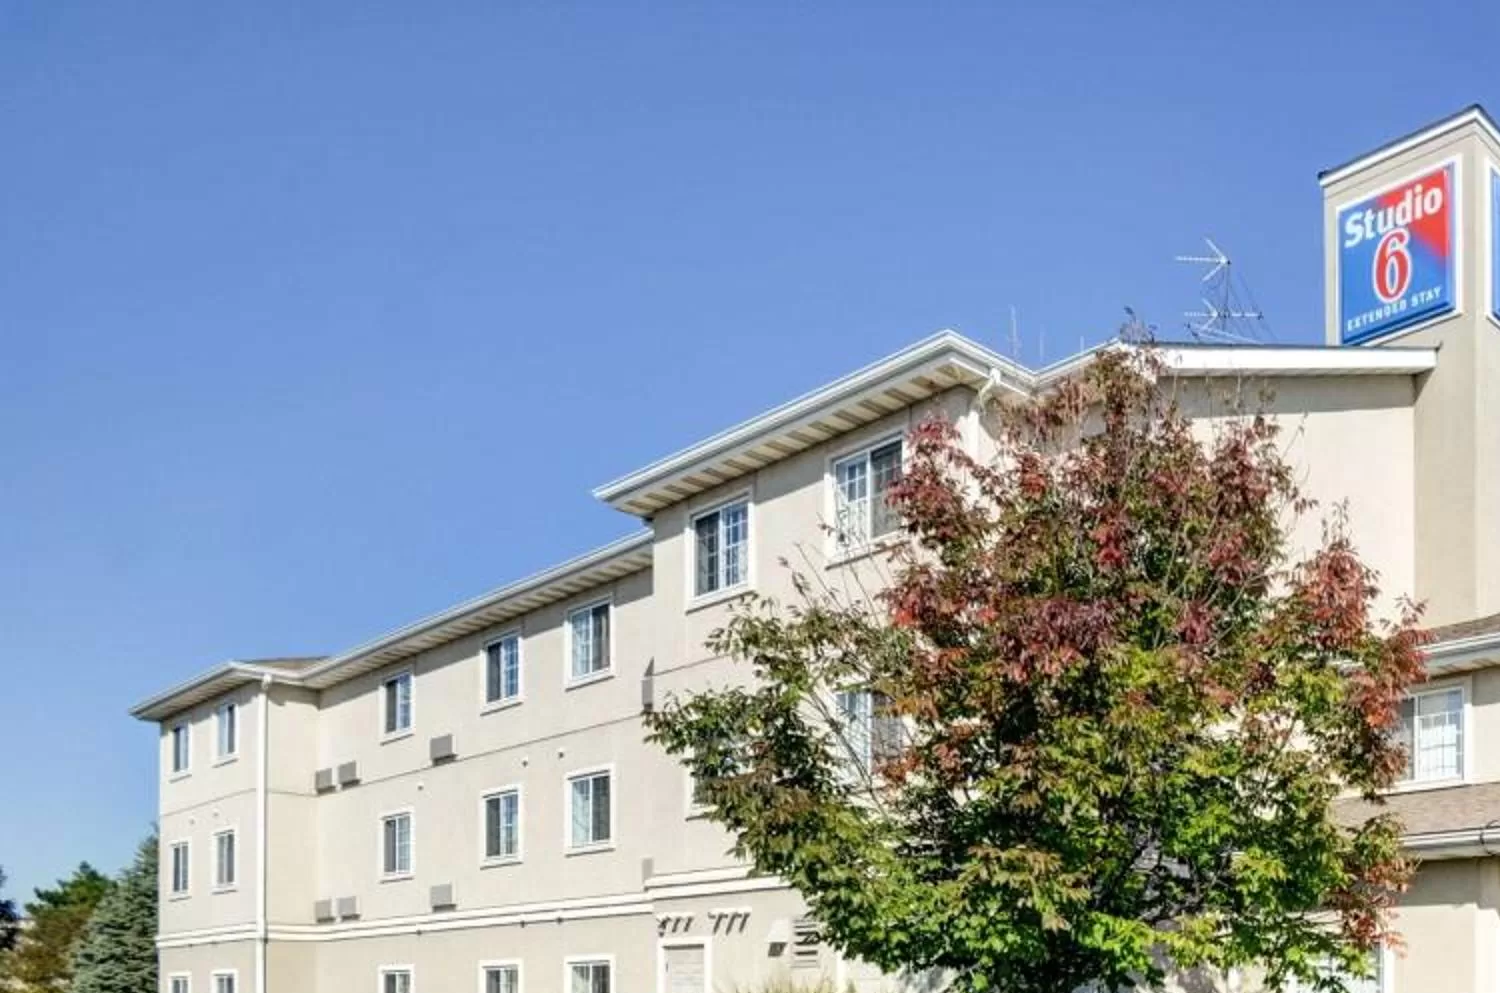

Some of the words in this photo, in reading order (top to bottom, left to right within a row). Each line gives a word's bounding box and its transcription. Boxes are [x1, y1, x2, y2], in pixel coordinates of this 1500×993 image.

[1344, 186, 1444, 249] Studio
[1373, 227, 1413, 304] 6
[1347, 299, 1407, 331] EXTENDED
[1411, 287, 1442, 306] STAY
